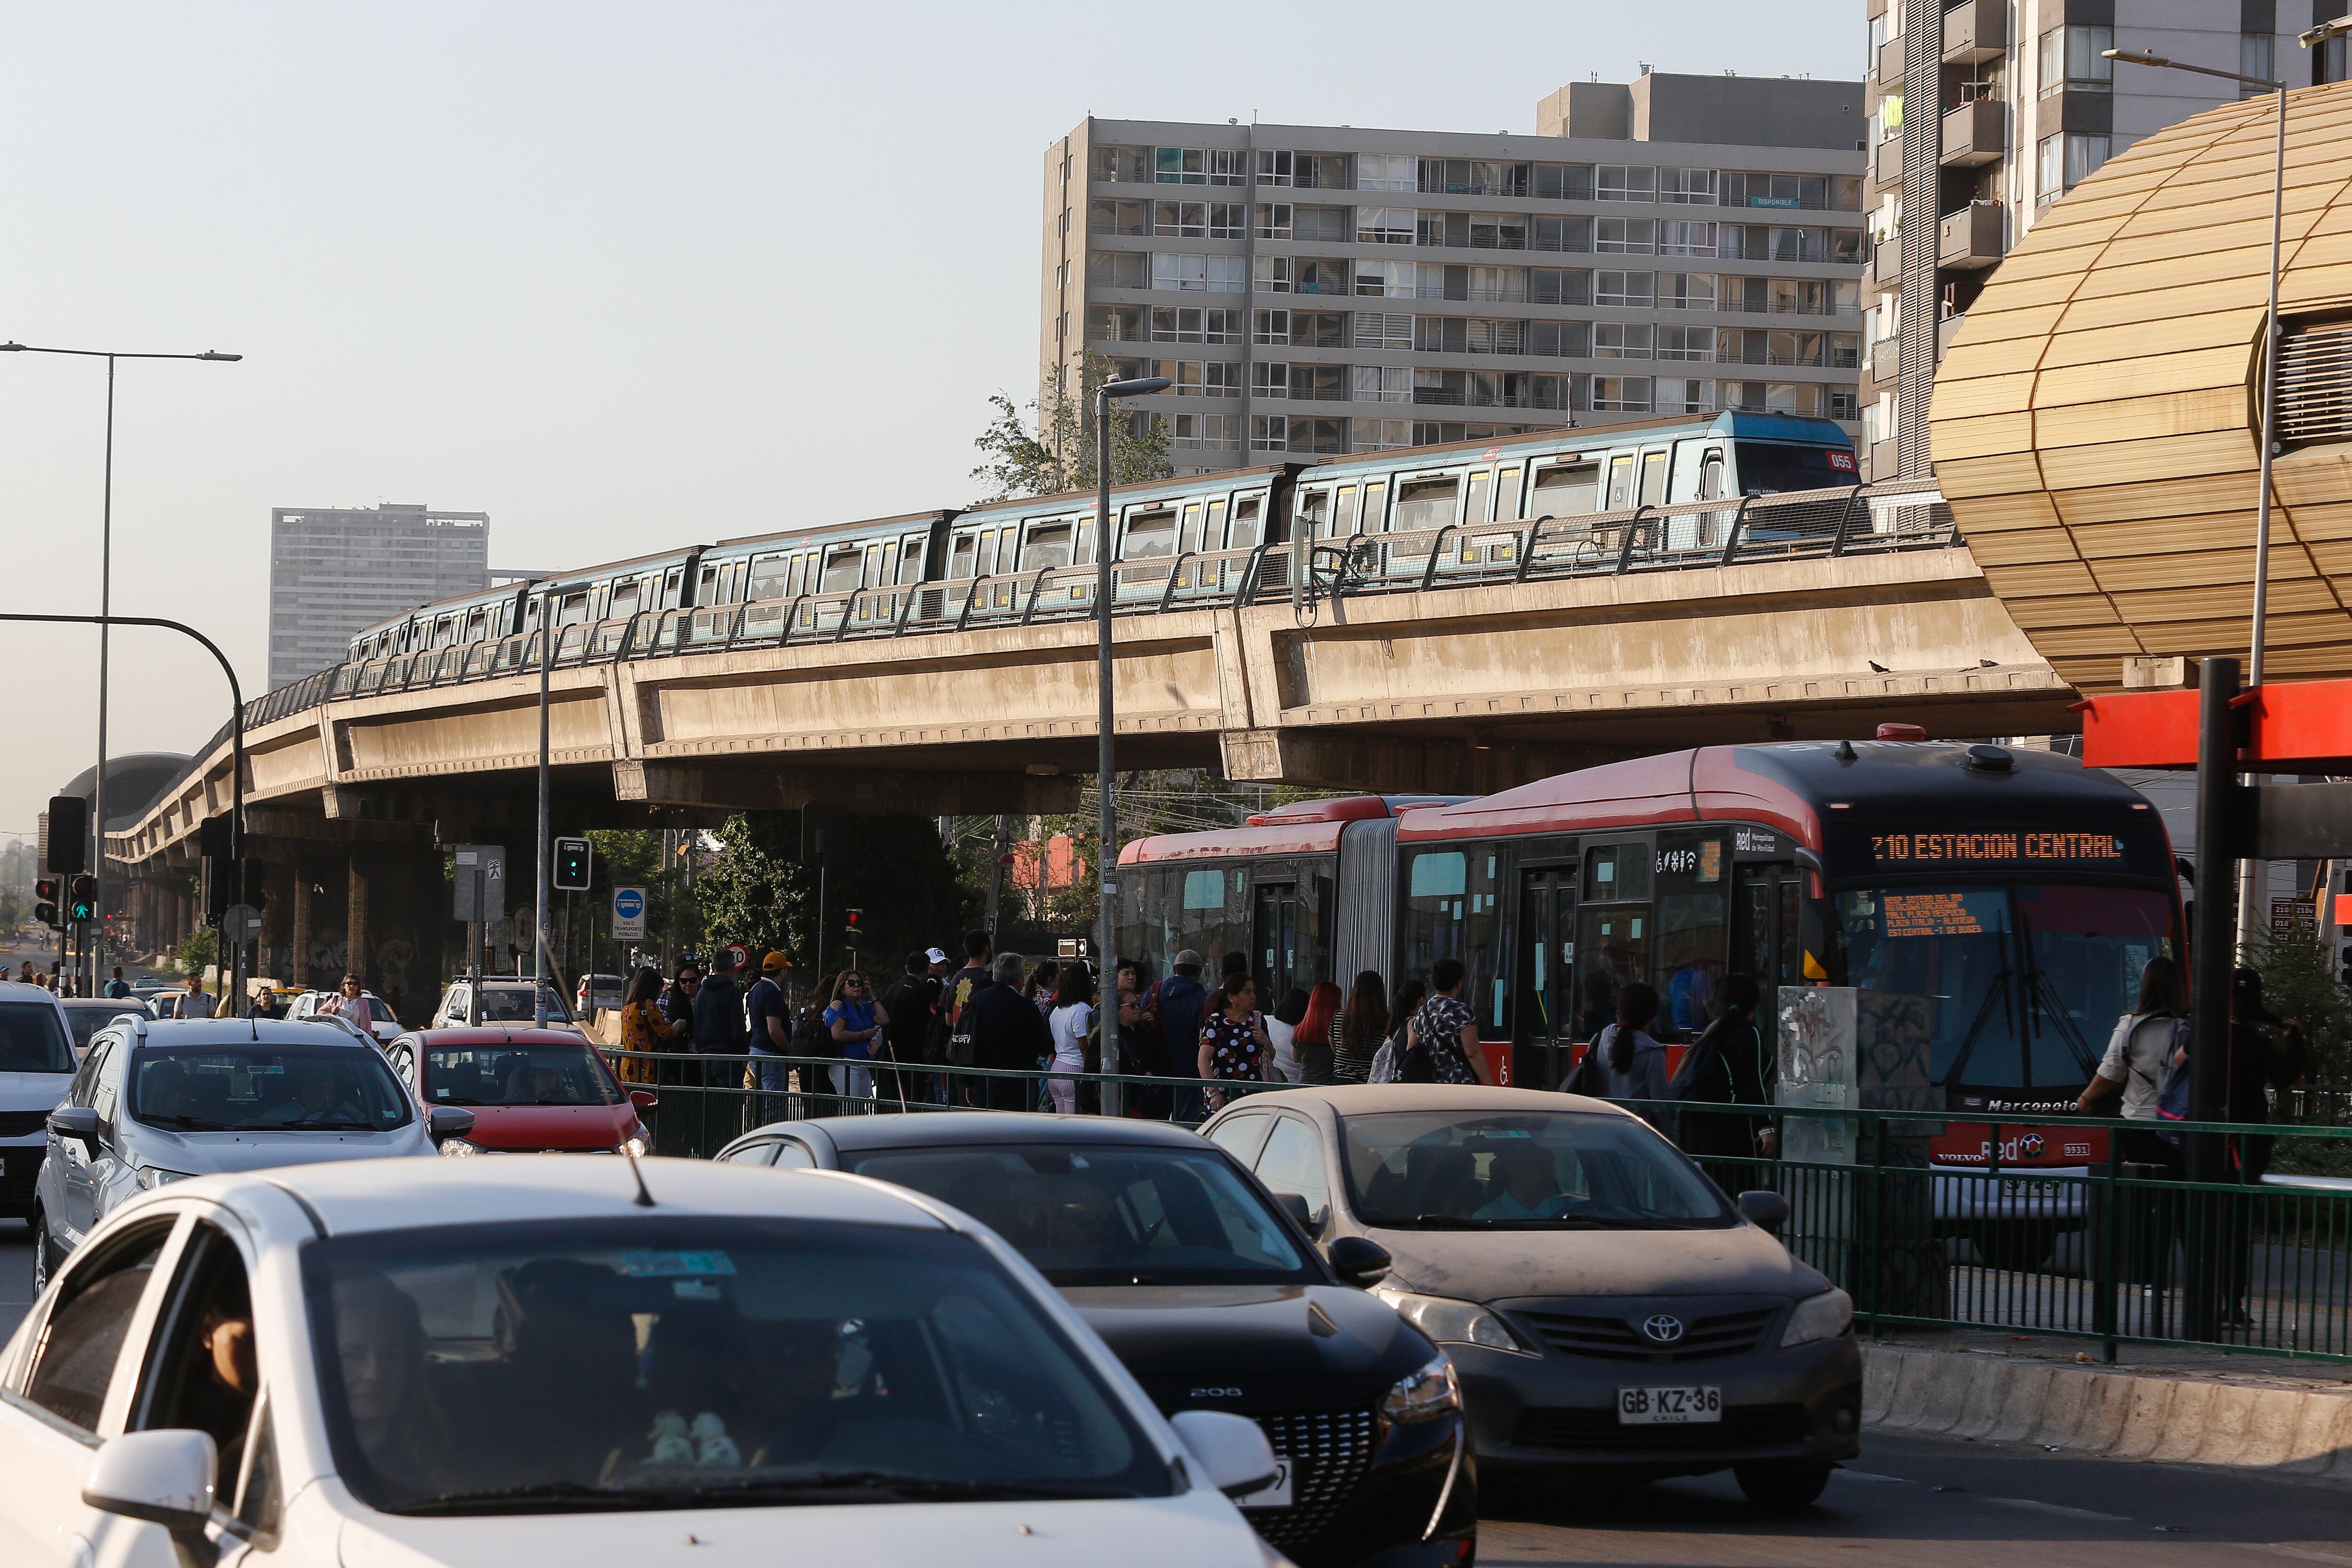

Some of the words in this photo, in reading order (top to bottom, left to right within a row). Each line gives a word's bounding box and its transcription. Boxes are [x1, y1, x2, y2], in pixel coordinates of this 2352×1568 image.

[1831, 454, 1852, 469] 055
[1736, 828, 1750, 851] Red
[1915, 834, 2018, 859] ESTACION
[2025, 834, 2121, 858] CENTRAL
[1987, 1100, 2078, 1113] Marcopolo
[1191, 1387, 1242, 1397] 208
